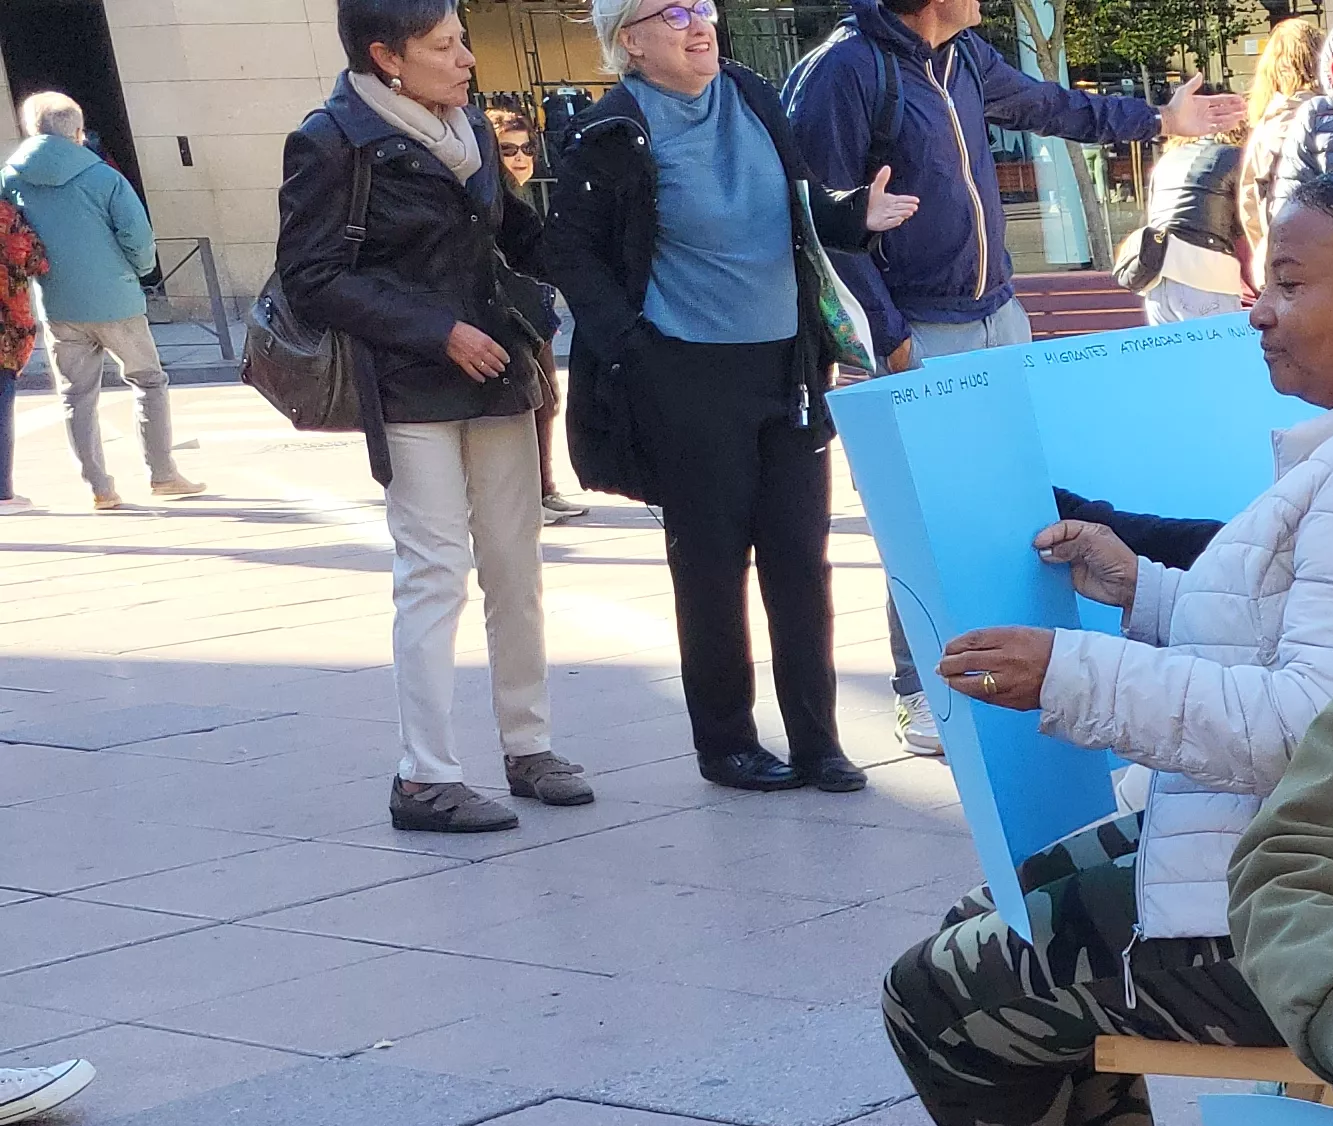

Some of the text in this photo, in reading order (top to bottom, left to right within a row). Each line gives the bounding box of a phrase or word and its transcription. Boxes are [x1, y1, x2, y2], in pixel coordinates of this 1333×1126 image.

[1043, 344, 1108, 364] MIGRANTES
[1120, 333, 1183, 354] ATRAPADAS
[1205, 328, 1222, 340] LA
[924, 384, 932, 398] A
[936, 378, 954, 396] SUS
